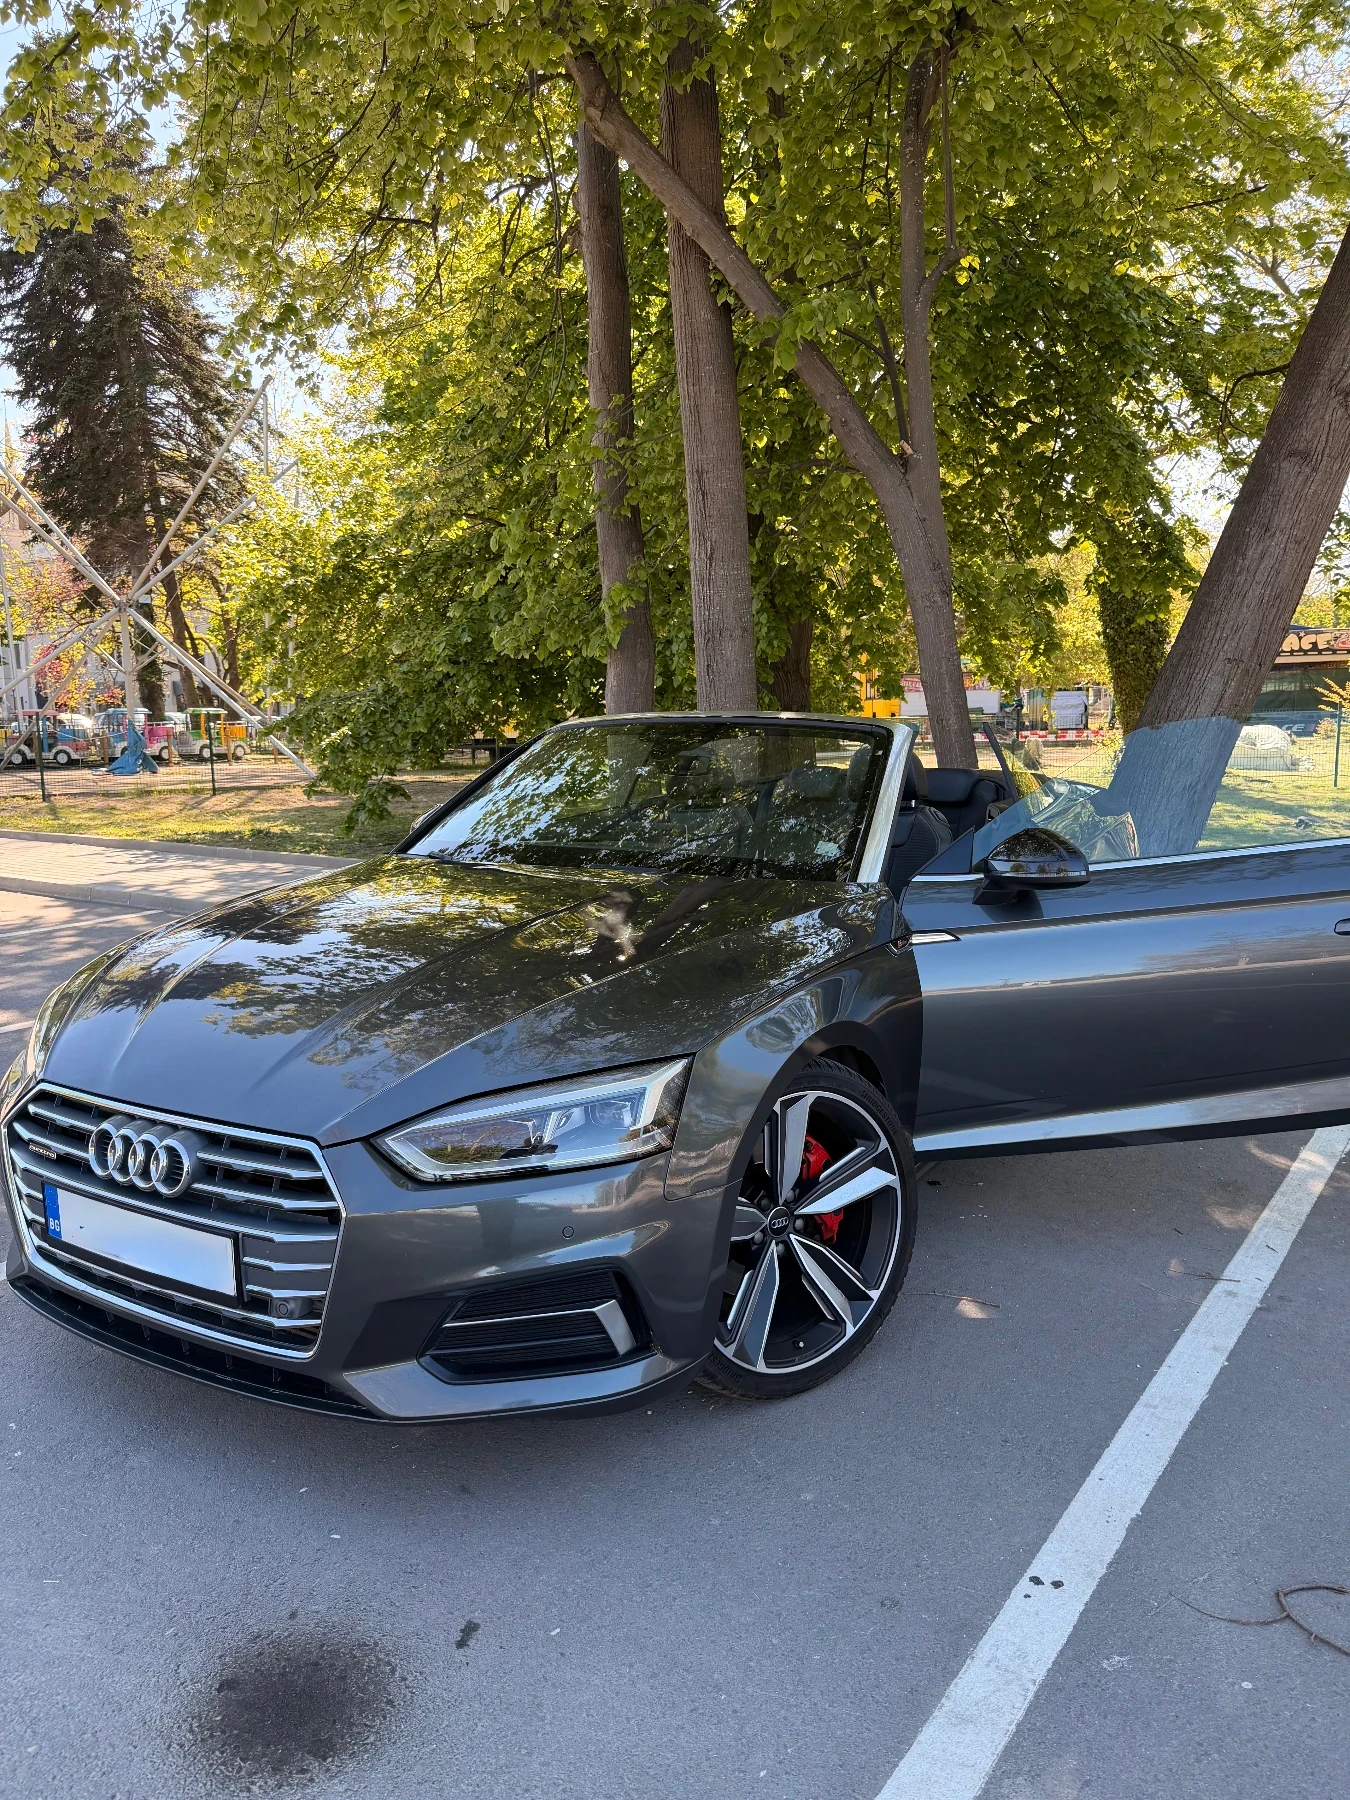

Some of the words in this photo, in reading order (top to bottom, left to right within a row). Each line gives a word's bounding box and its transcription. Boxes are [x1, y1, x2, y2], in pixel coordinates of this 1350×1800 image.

[1280, 633, 1332, 651] ACE
[861, 1089, 899, 1136] BRIDGESTONE
[50, 1217, 60, 1232] BG
[707, 1353, 743, 1383] BRIDGEST
